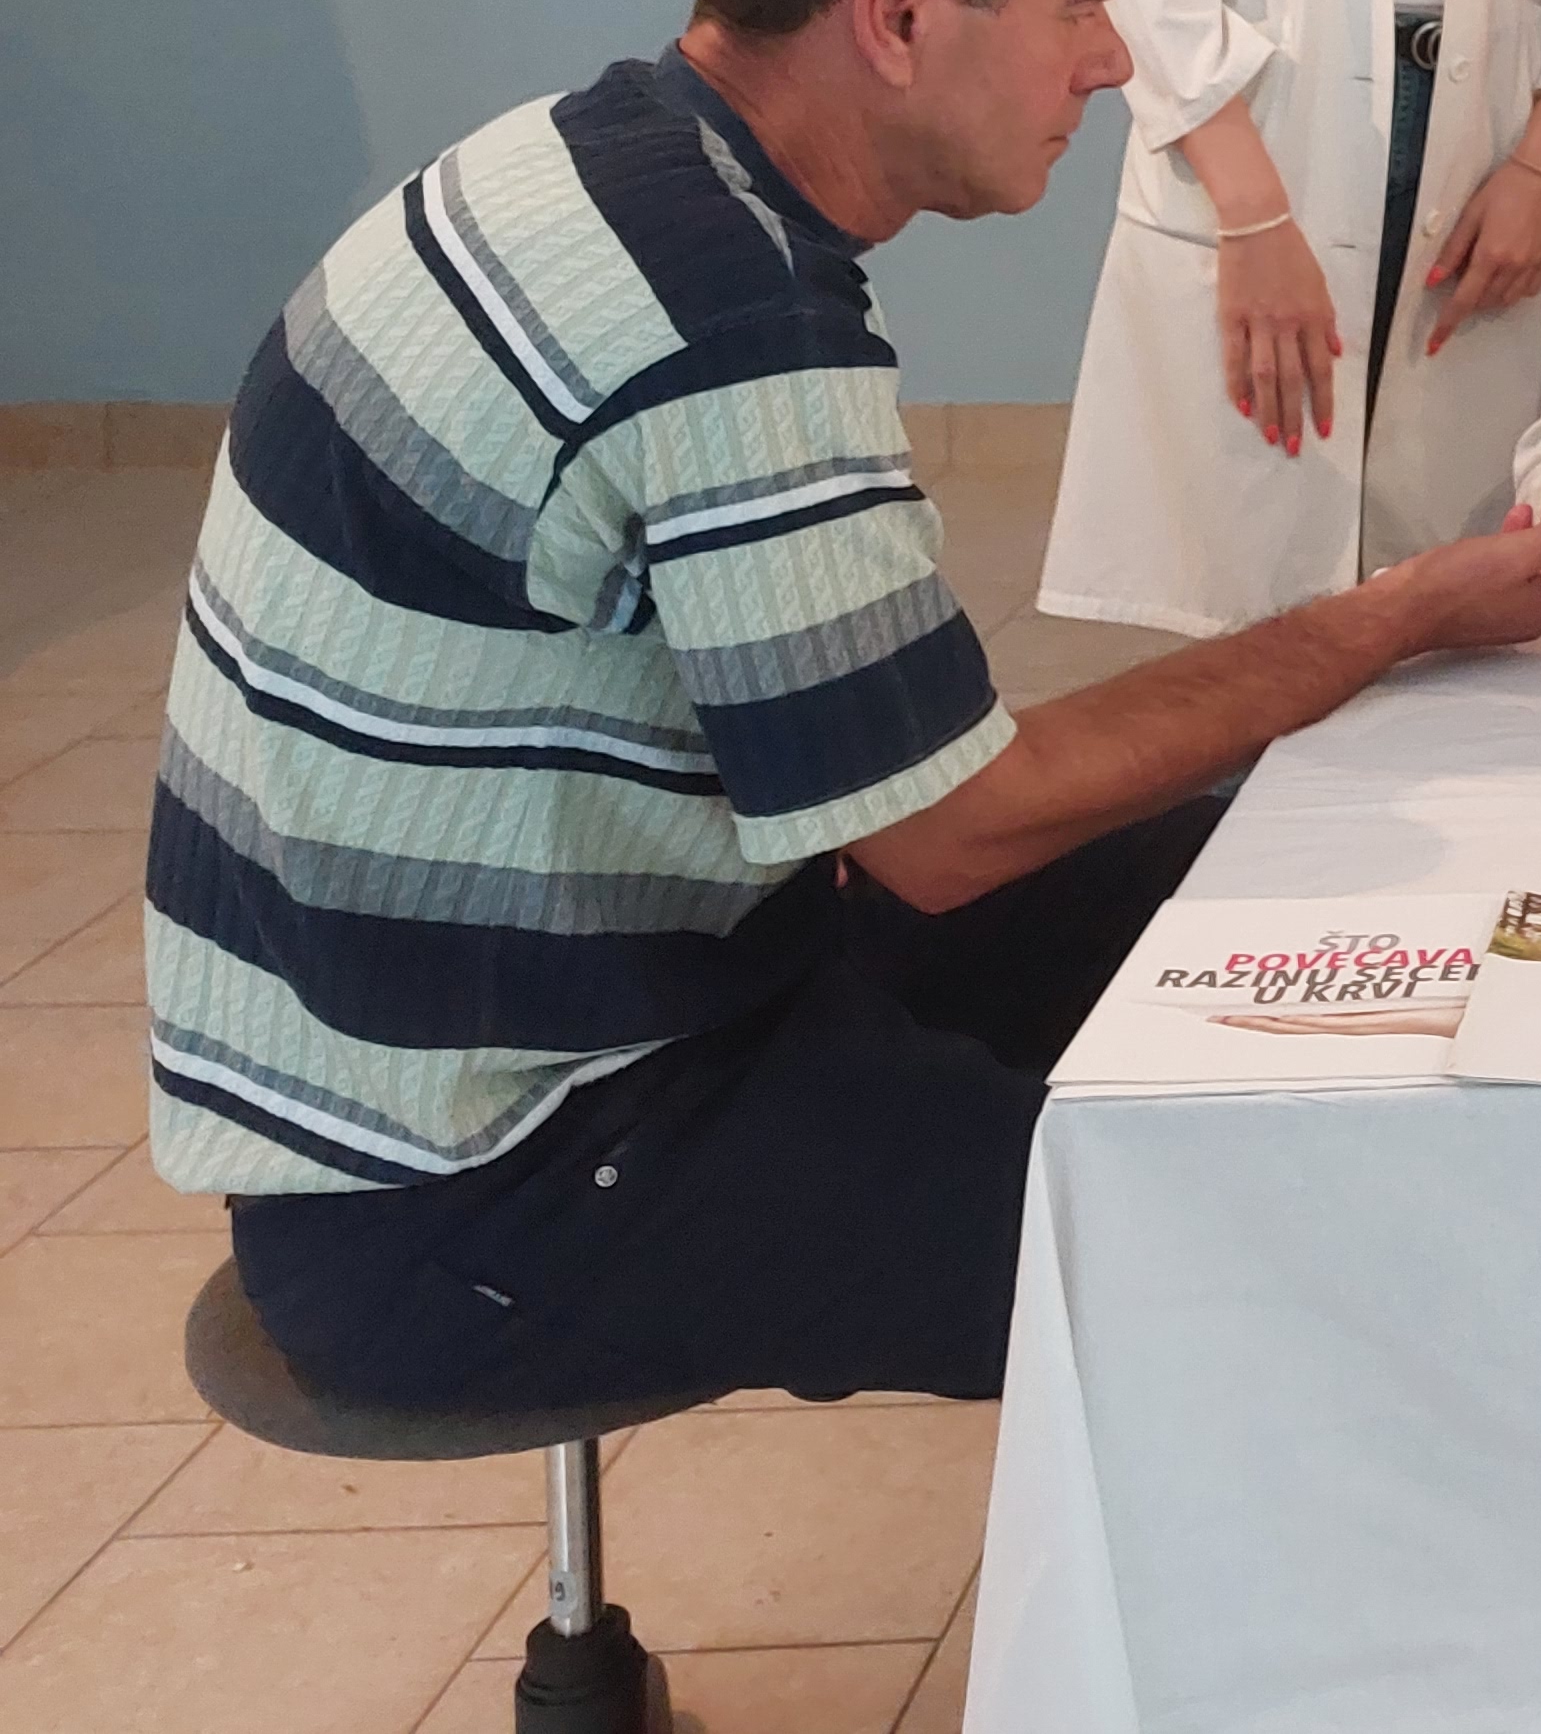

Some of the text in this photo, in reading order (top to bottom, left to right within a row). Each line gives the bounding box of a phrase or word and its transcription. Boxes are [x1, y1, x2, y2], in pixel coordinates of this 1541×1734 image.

[1315, 929, 1401, 954] ŠTO
[1155, 968, 1339, 989] RAZINU
[1253, 980, 1419, 1005] U KRVI
